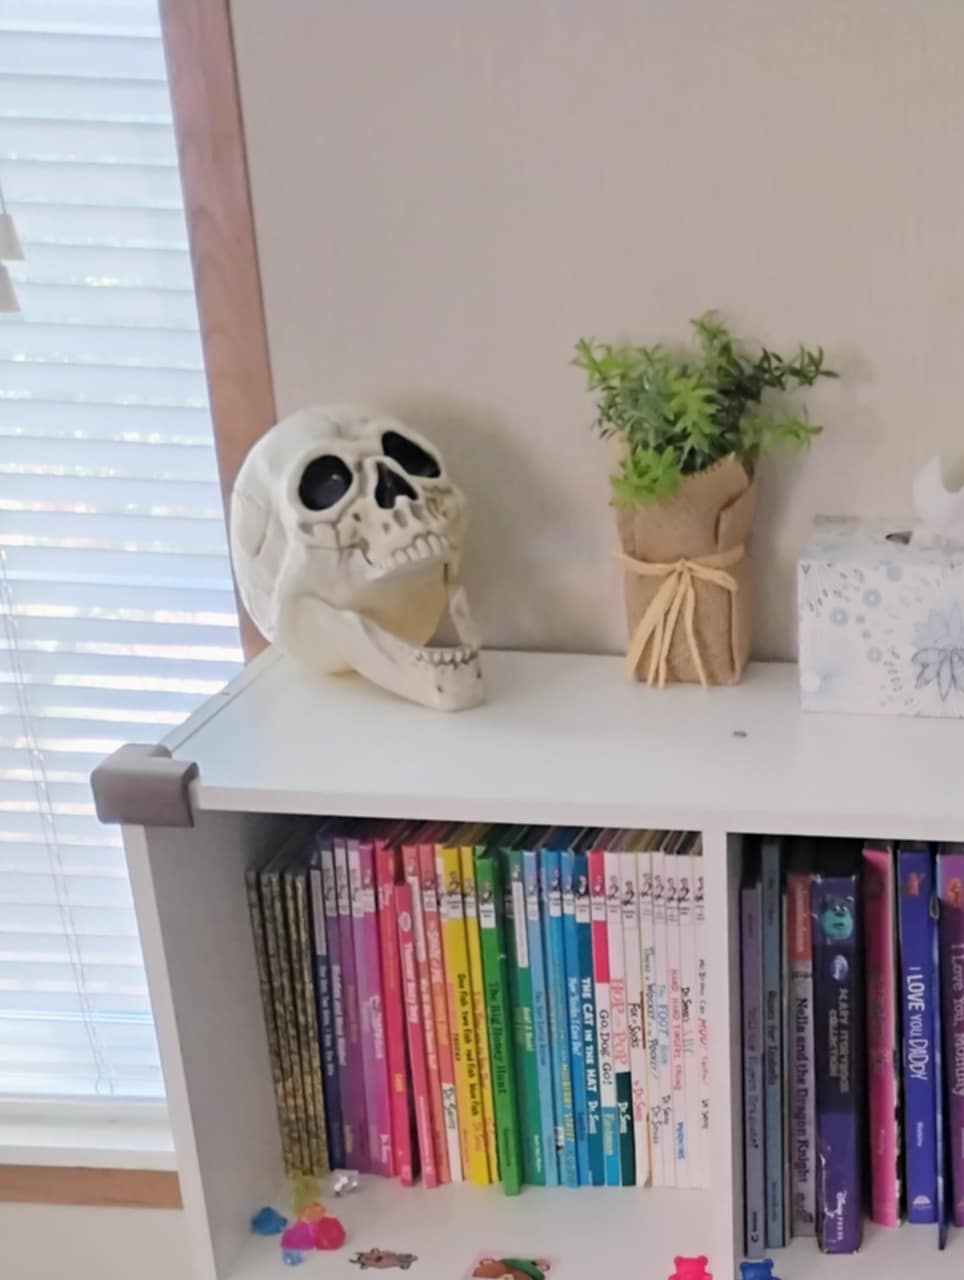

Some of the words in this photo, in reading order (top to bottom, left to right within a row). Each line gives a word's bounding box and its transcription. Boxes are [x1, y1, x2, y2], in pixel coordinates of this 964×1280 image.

[456, 972, 466, 989] One
[580, 976, 591, 999] THE
[458, 990, 469, 1007] fish
[487, 982, 499, 1002] The
[610, 978, 624, 1014] HOP
[906, 974, 926, 1011] LOVE
[460, 1010, 470, 1026] two
[489, 1005, 502, 1025] Big
[582, 1003, 593, 1025] CAT
[629, 1003, 640, 1018] Fox
[794, 998, 807, 1033] Nella
[462, 1028, 473, 1045] fish
[490, 1027, 505, 1063] Honey
[612, 1030, 626, 1064] POP
[629, 1024, 641, 1048] Socks
[464, 1048, 474, 1061] red
[585, 1045, 593, 1063] THE
[795, 1036, 807, 1060] and
[906, 1037, 931, 1080] DADDY
[466, 1063, 476, 1078] fish
[495, 1064, 508, 1095] Hunt
[585, 1068, 596, 1092] HAT
[796, 1063, 807, 1084] the
[468, 1081, 478, 1099] blue
[470, 1099, 480, 1116] fish
[793, 1088, 809, 1136] Dragon
[794, 1139, 811, 1183] Knight
